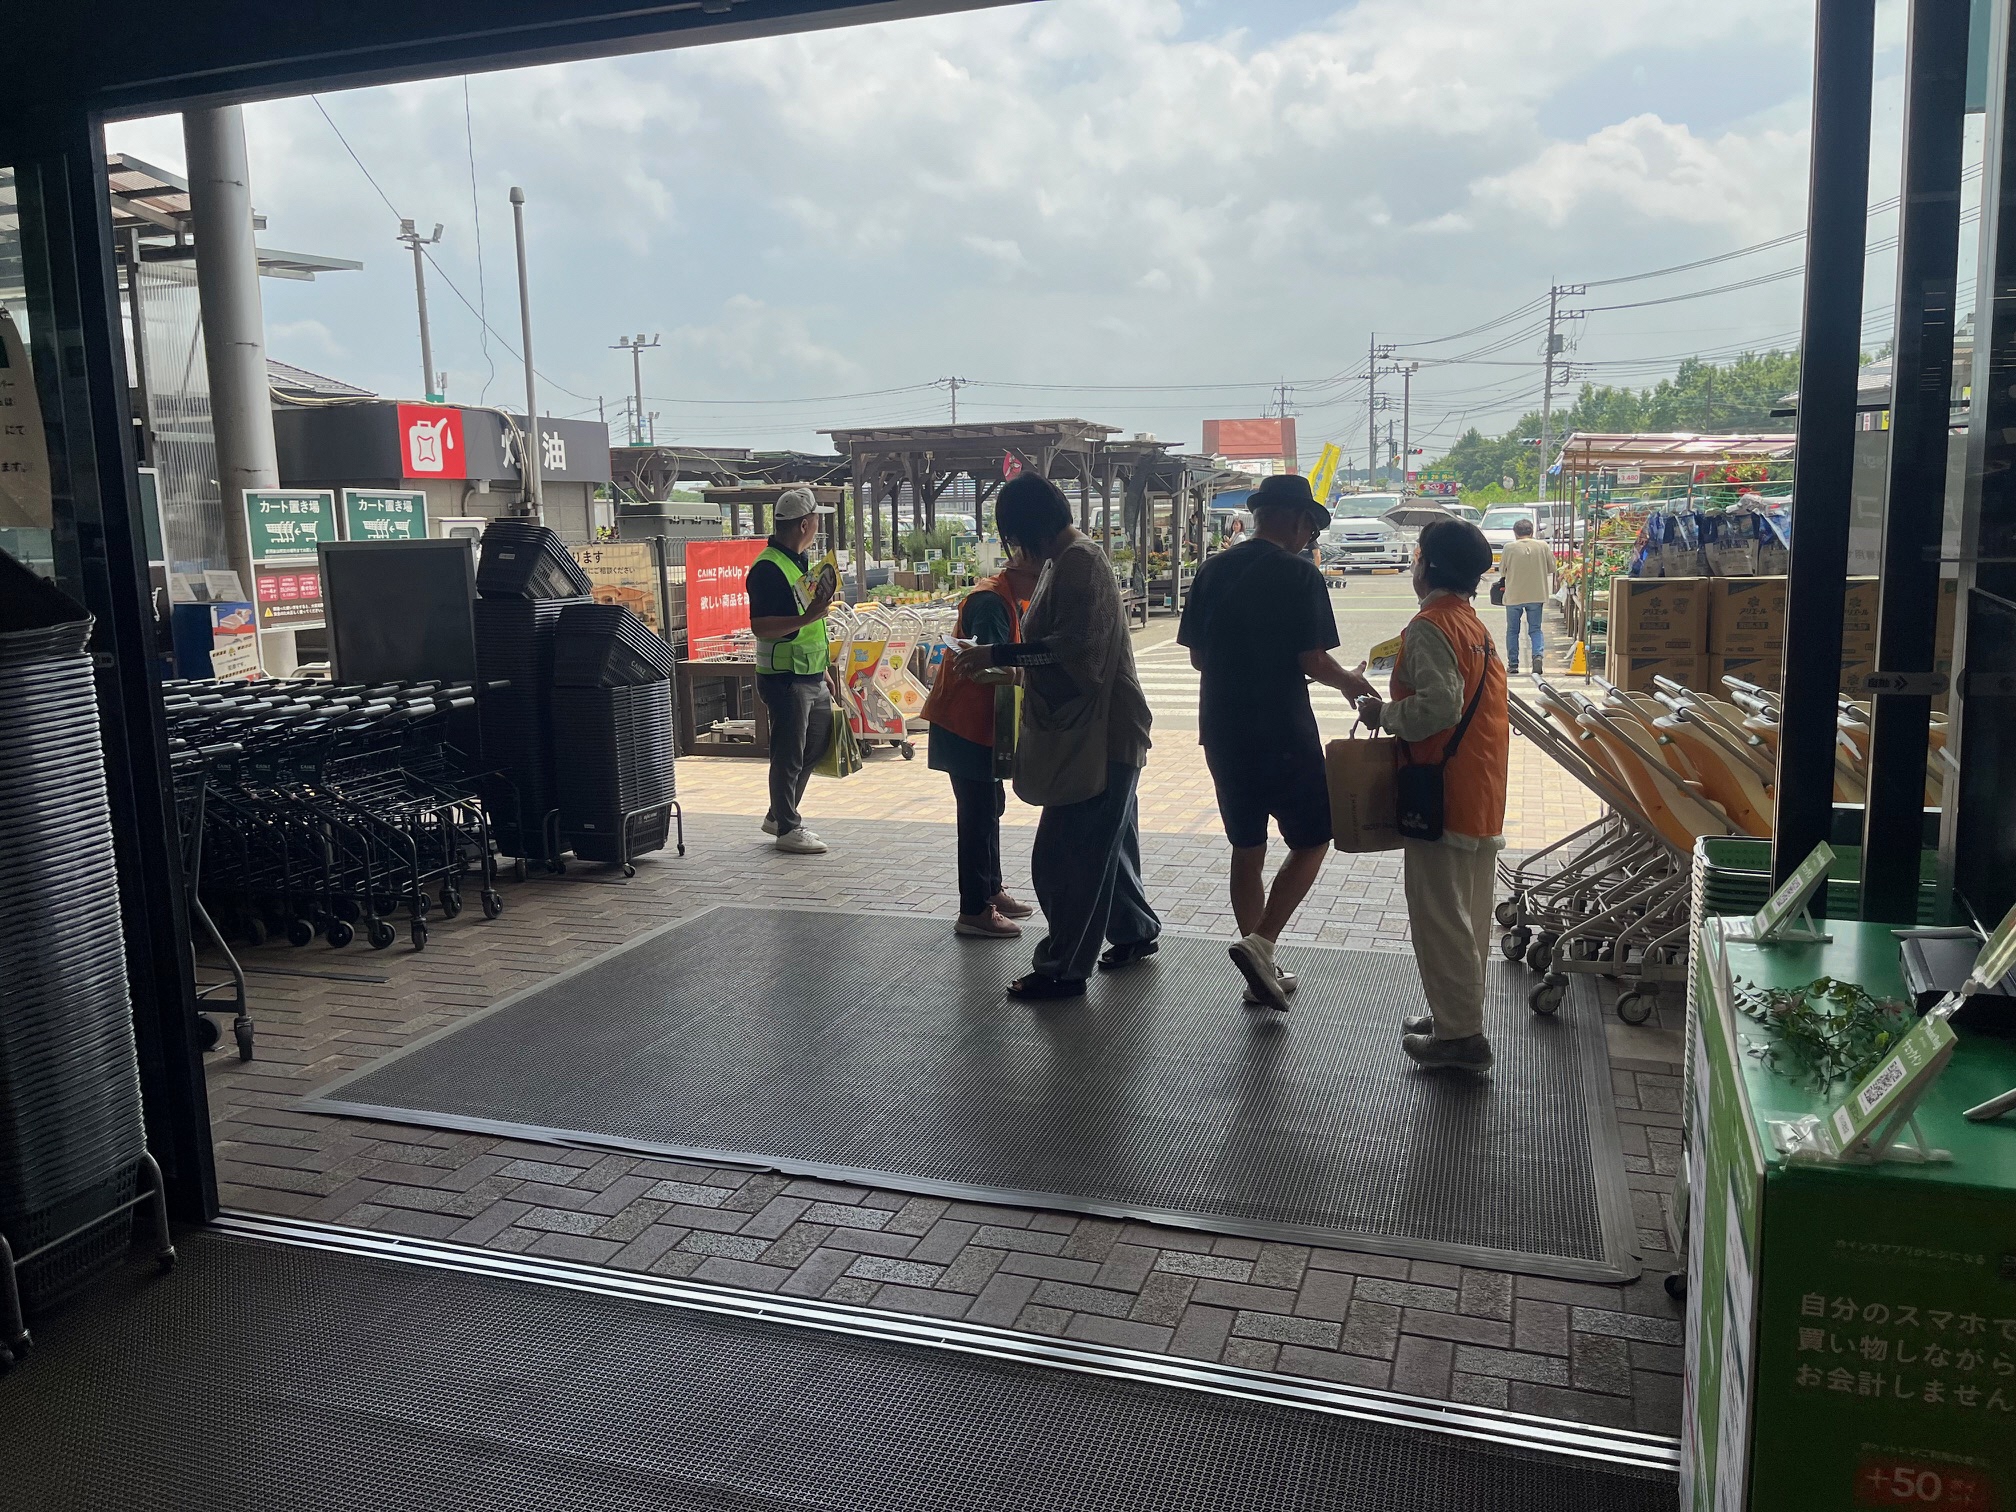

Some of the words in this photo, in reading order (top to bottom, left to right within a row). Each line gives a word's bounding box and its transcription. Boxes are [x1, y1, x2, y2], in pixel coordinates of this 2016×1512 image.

[501, 428, 567, 470] 灯油
[259, 500, 320, 514] カート置き場
[358, 499, 413, 513] カート置き場
[572, 550, 603, 564] ります
[697, 568, 717, 578] CAINZ
[718, 565, 743, 580] PickUp
[1641, 608, 1669, 616] アリエール
[630, 660, 647, 676] CAINZ
[1902, 1038, 1922, 1067] チェックイン
[1836, 1239, 1985, 1266] カインズアプリがレジになる
[1801, 1292, 2016, 1342] 自分のスマホで
[1798, 1326, 2016, 1376] 買い物しながら
[1795, 1363, 2015, 1412] お会計しません
[1864, 1467, 1943, 1502] +50
